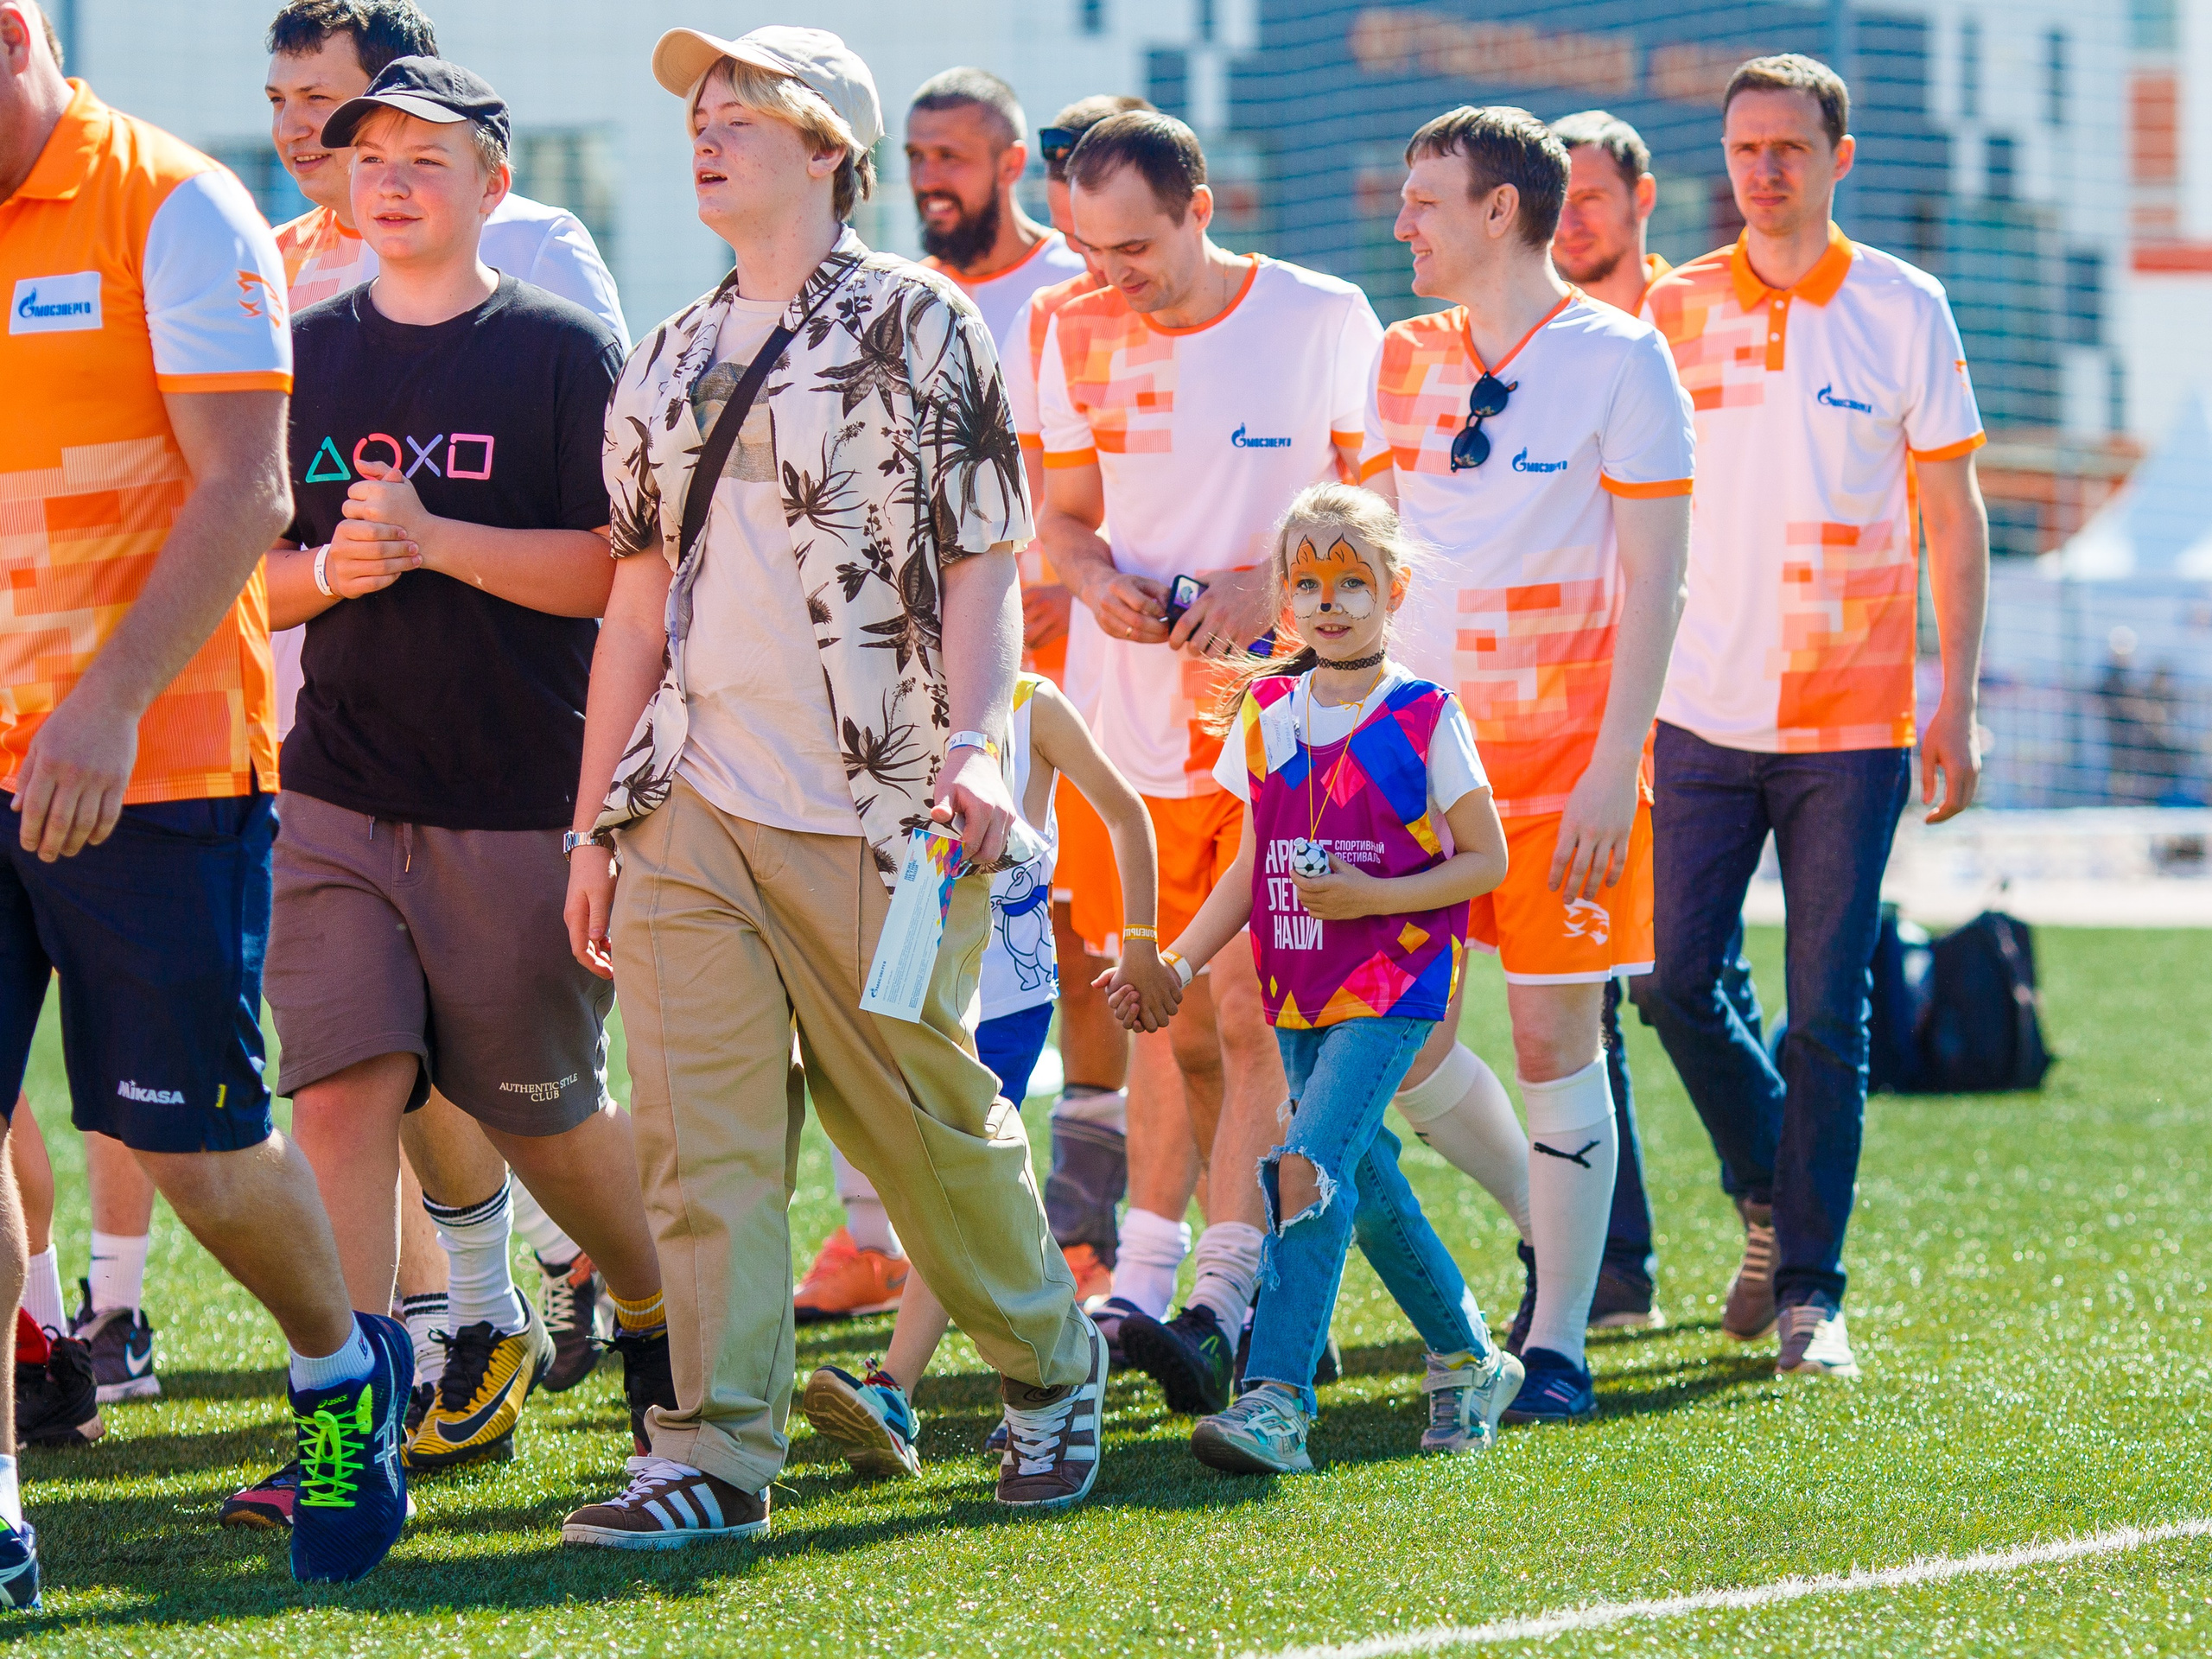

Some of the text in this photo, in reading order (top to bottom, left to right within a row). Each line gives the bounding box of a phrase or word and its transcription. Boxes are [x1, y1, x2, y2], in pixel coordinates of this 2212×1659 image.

[35, 302, 91, 317] МОСЭНЕРГО
[1334, 840, 1385, 855] СПОРТИВНЫЙ
[1334, 852, 1381, 864] ФЕСТИВАЛЬ
[1267, 878, 1309, 912] ЛЕТ
[1274, 915, 1323, 950] НАШИ
[499, 1072, 578, 1093] AUTHENTIC STYLE
[531, 1090, 560, 1102] CLUB
